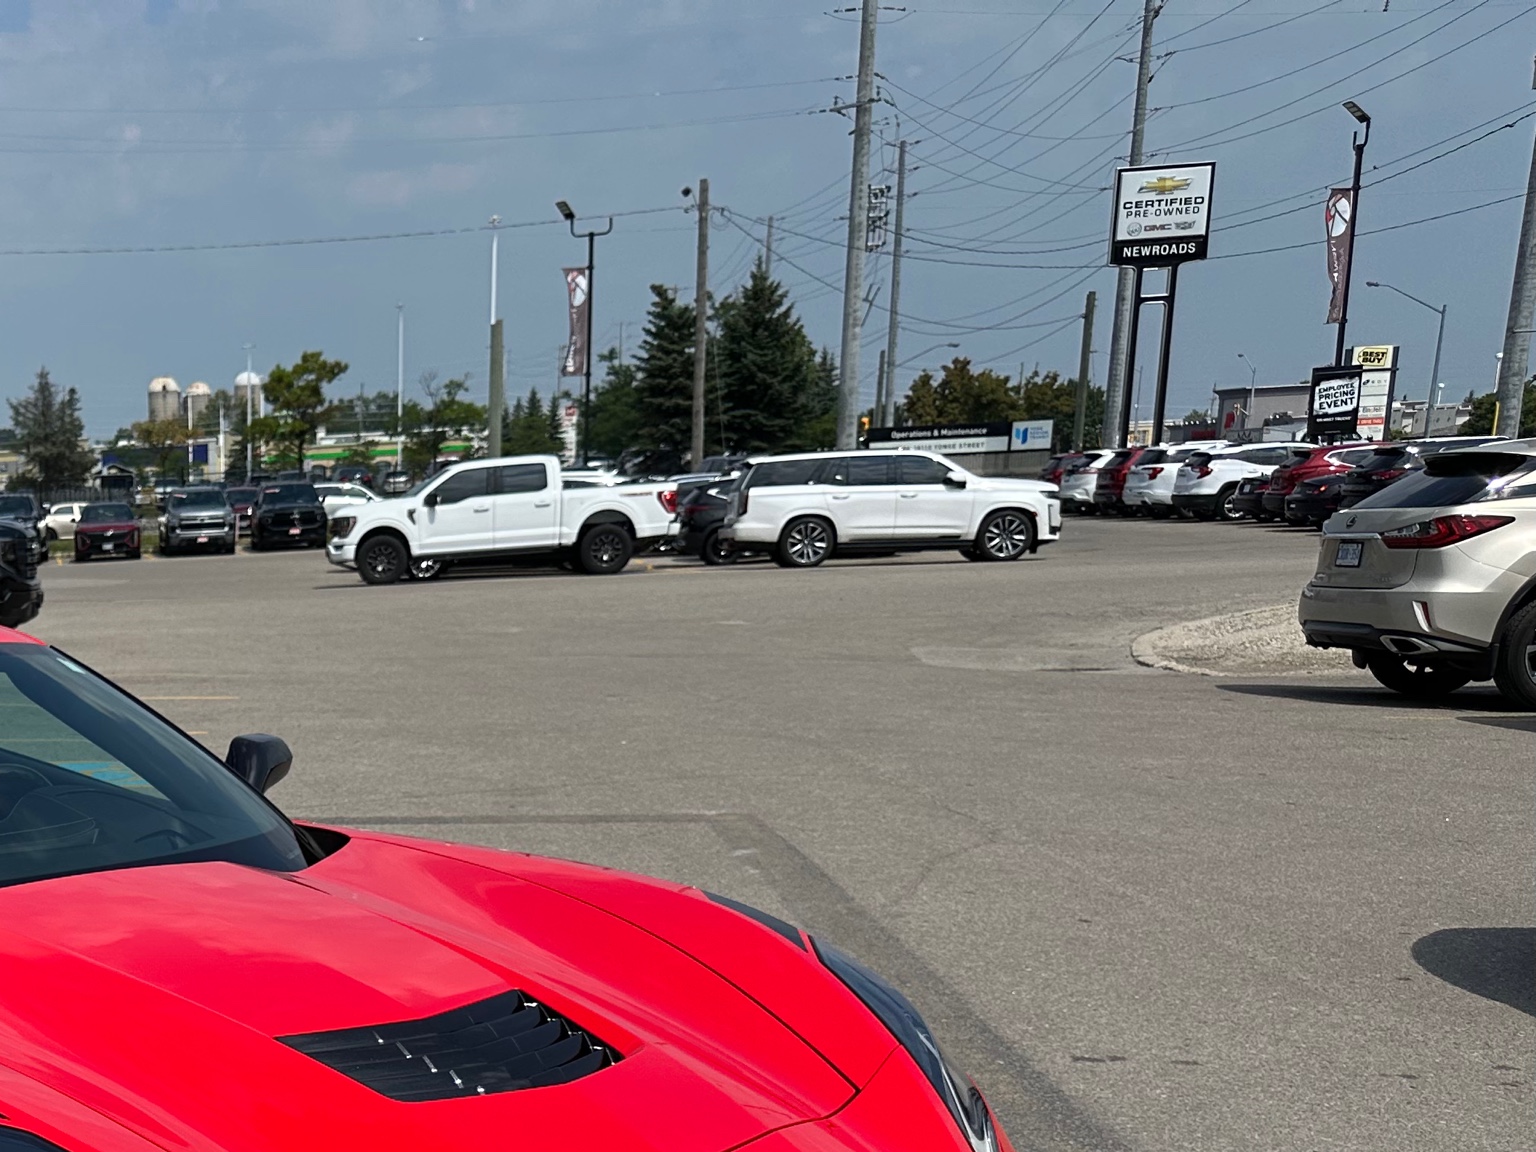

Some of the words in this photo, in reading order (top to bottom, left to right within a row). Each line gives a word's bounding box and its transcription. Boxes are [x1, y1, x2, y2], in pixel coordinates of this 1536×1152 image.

[1123, 196, 1204, 210] CERTIFIED
[1126, 206, 1200, 218] PRE-OWNED
[1123, 242, 1196, 257] NEWROADS
[1318, 383, 1355, 394] EMPLOYEE
[1318, 389, 1355, 401] PRICING
[1319, 397, 1355, 410] EVENT
[891, 429, 931, 439] Operations
[933, 429, 938, 437] &
[940, 427, 988, 437] Maintenance
